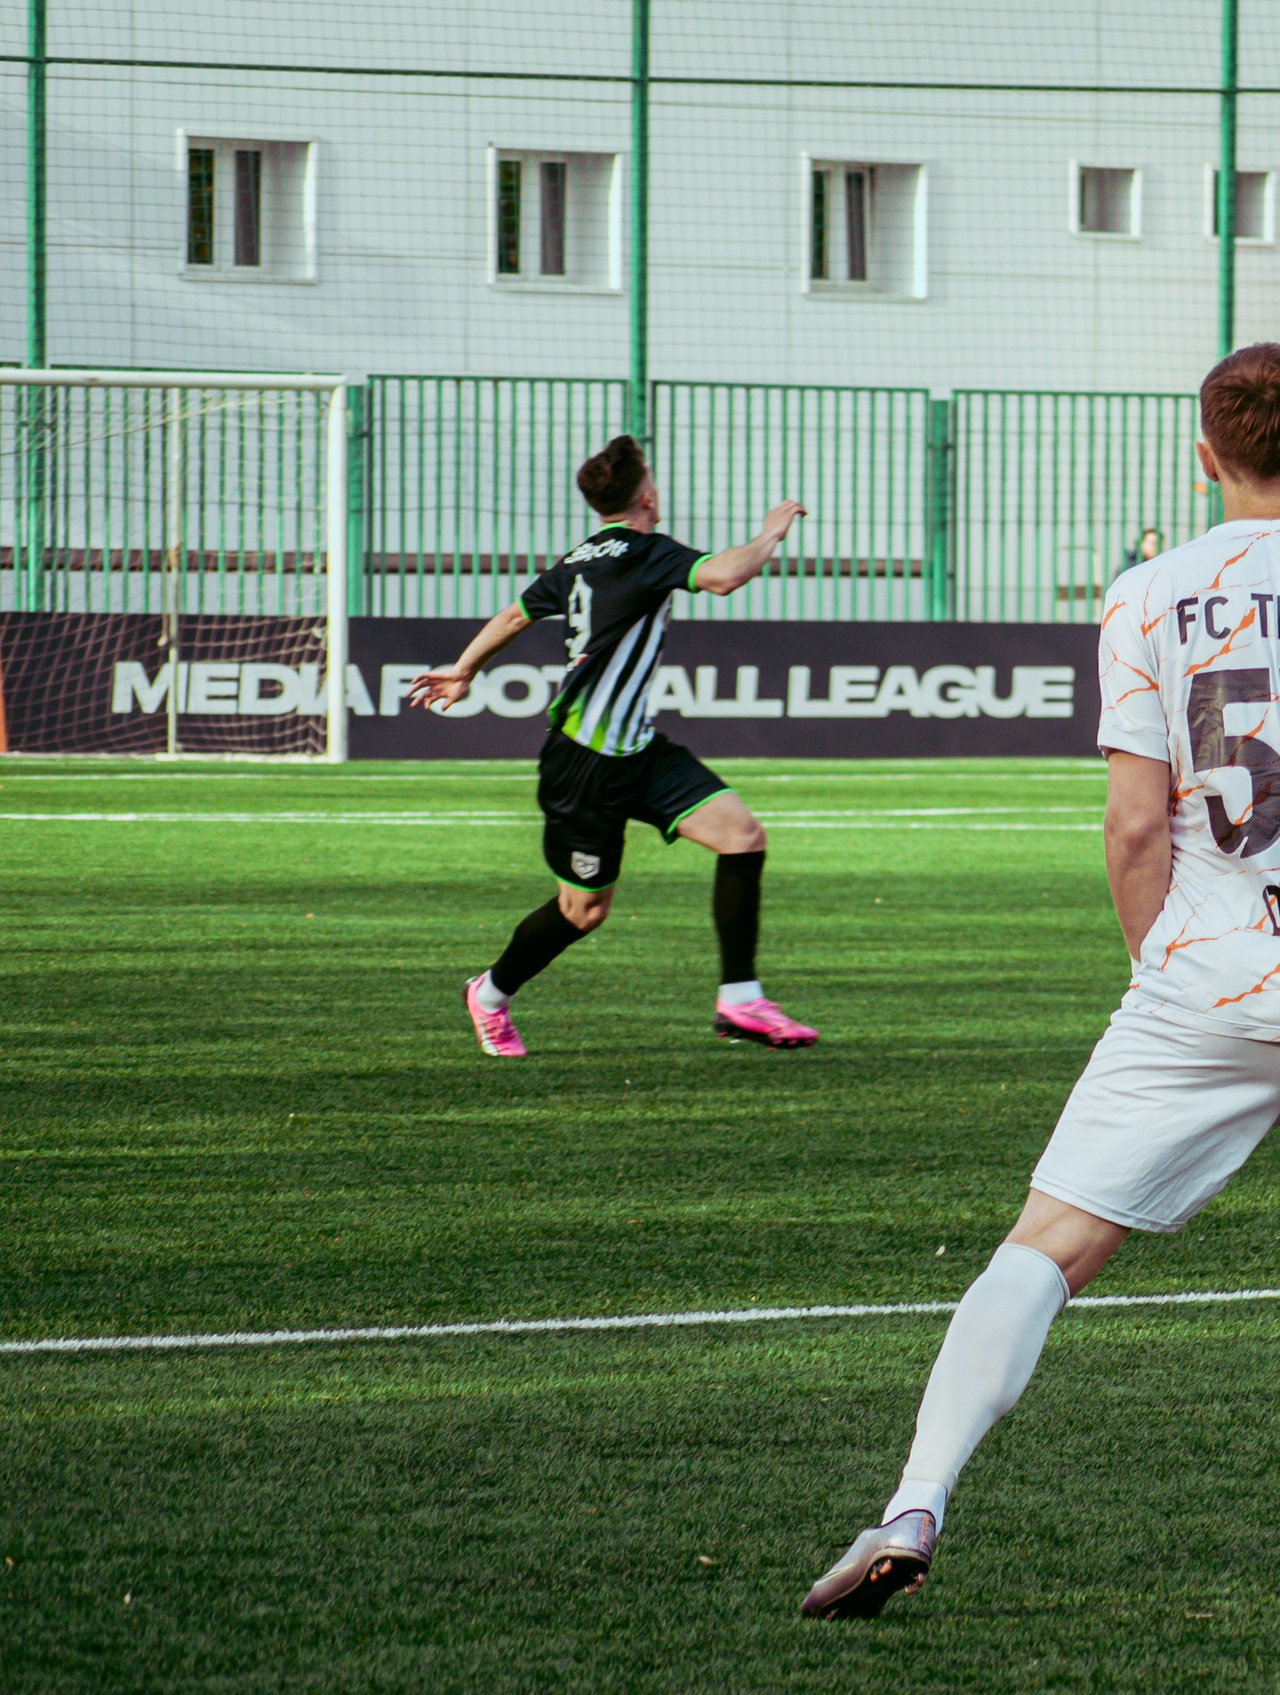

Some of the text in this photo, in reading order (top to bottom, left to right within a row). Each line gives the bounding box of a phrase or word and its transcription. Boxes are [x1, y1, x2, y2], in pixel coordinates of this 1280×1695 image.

[1176, 596, 1232, 645] FC
[112, 660, 1075, 719] MEDIA FOOALL LEAGUE
